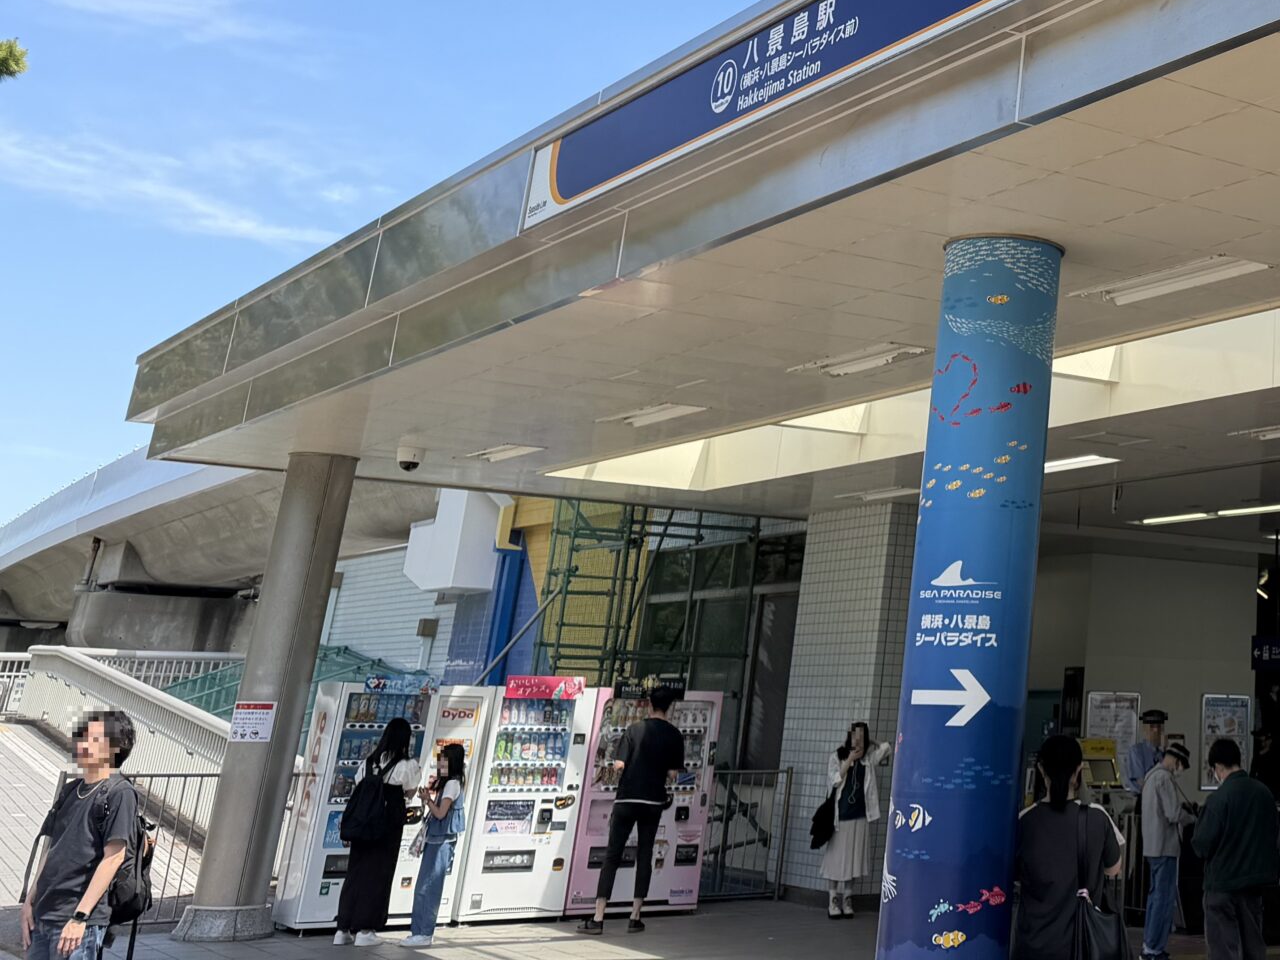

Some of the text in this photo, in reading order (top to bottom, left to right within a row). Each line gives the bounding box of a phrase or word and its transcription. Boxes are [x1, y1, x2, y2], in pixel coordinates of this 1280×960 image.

[717, 67, 733, 97] 10
[736, 78, 785, 111] Hakkeijima
[787, 61, 821, 87] Station
[920, 590, 1002, 599] SEA PARADISE
[921, 614, 991, 630] 横浜・八景島
[915, 632, 998, 648] シーパラダイス
[441, 710, 473, 720] DyDo
